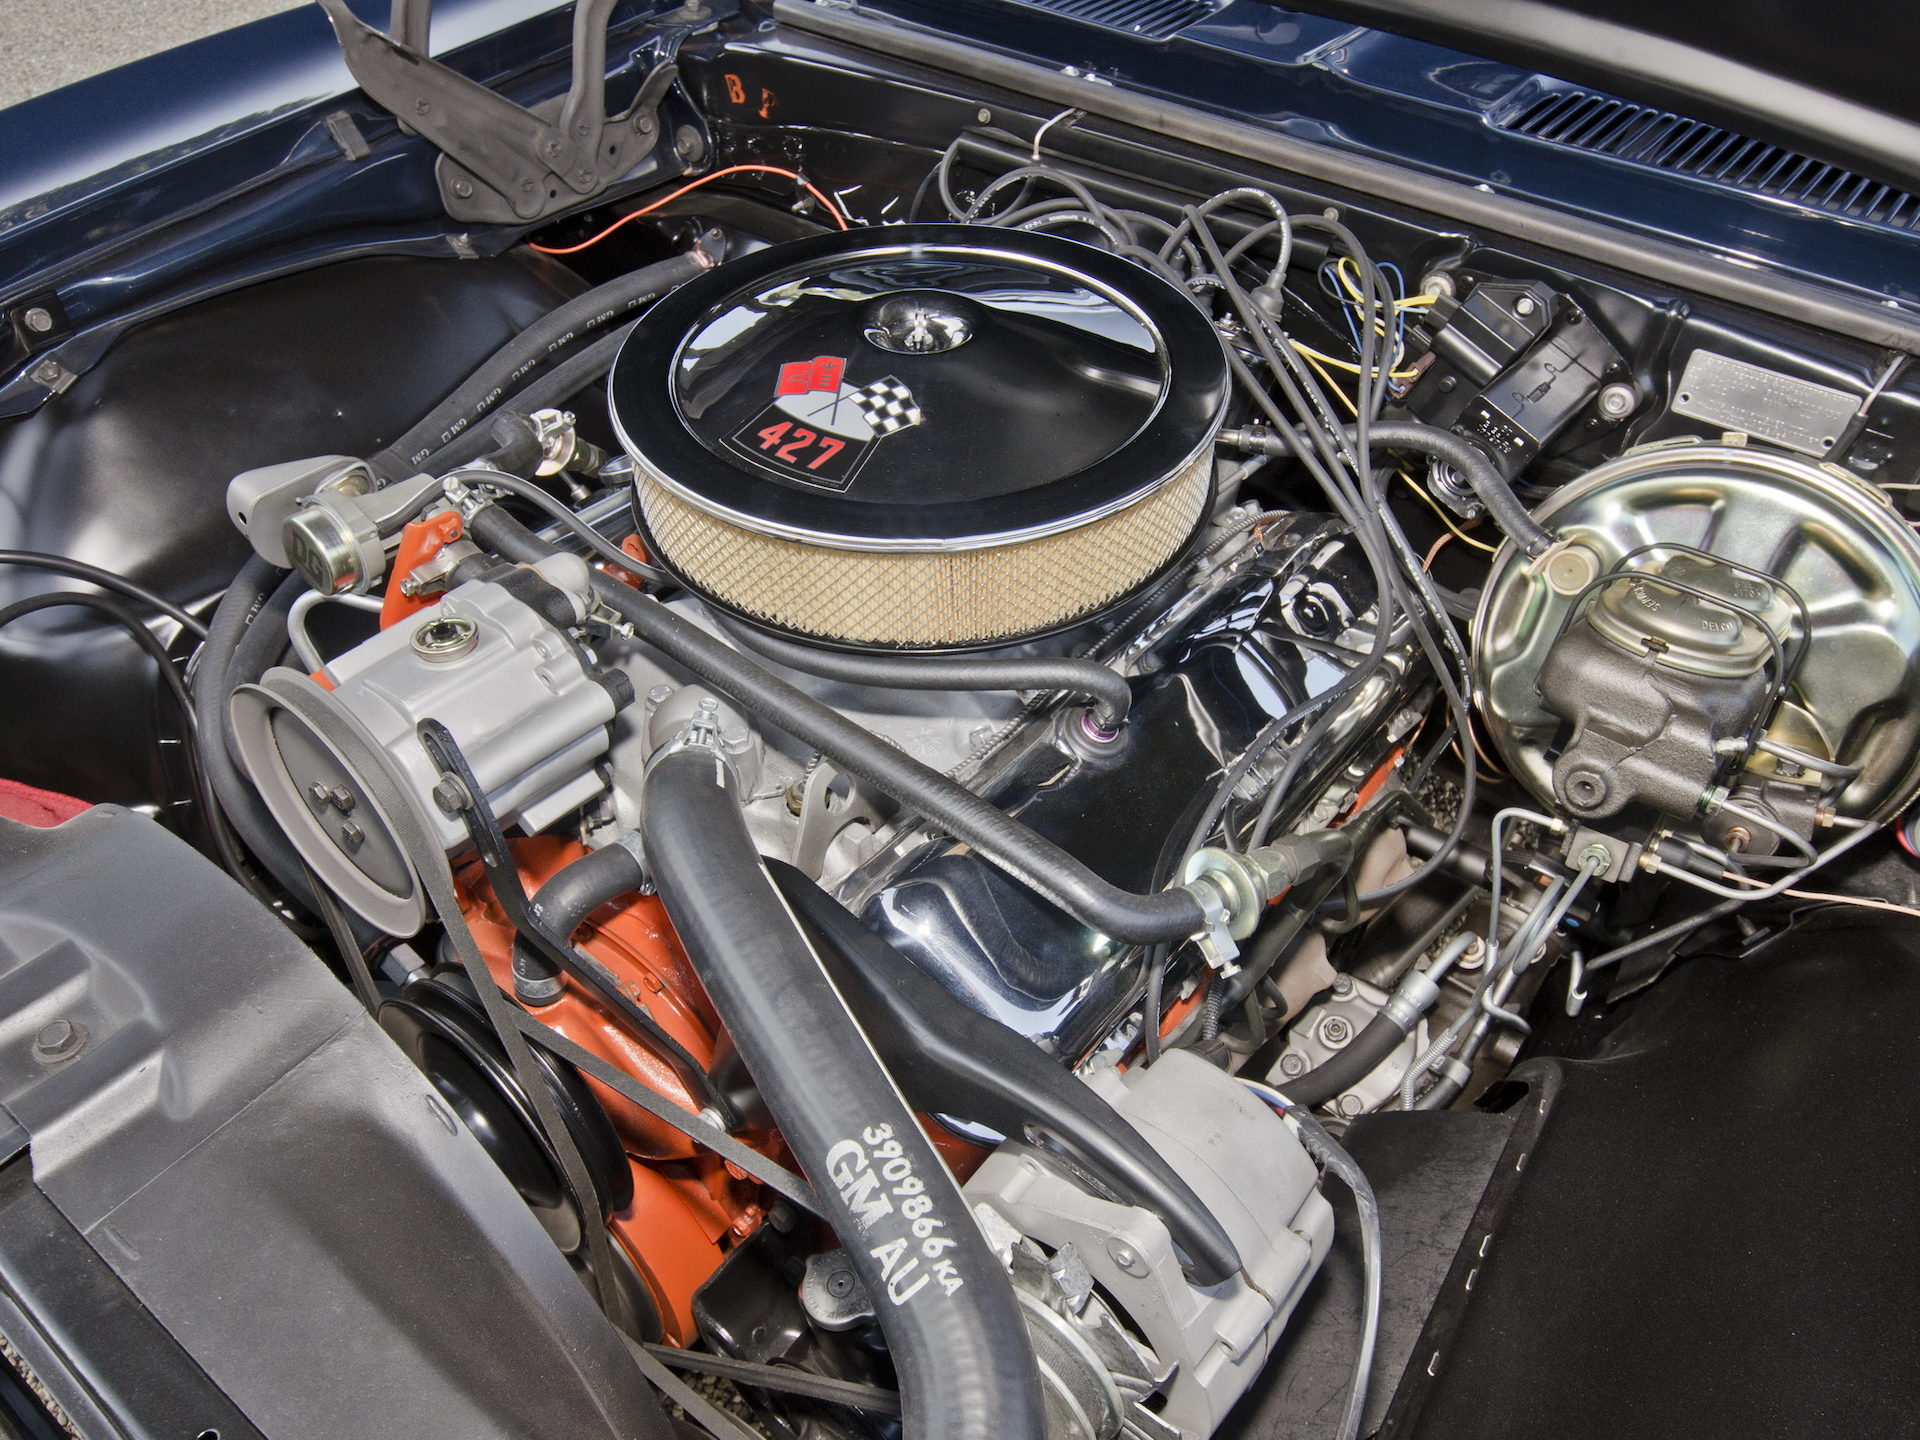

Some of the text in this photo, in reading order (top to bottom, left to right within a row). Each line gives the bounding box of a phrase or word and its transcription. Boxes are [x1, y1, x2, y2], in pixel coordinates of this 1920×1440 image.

[724, 73, 746, 104] B
[597, 309, 615, 324] GM
[556, 331, 574, 347] GM
[520, 358, 536, 375] GM
[486, 387, 502, 406] GM
[450, 417, 468, 437] GM
[757, 420, 847, 470] 427
[410, 447, 430, 466] GM
[1701, 619, 1733, 633] DELCO
[1444, 629, 1460, 654] PACKARD
[825, 1139, 894, 1234] GM
[869, 1237, 930, 1306] AU
